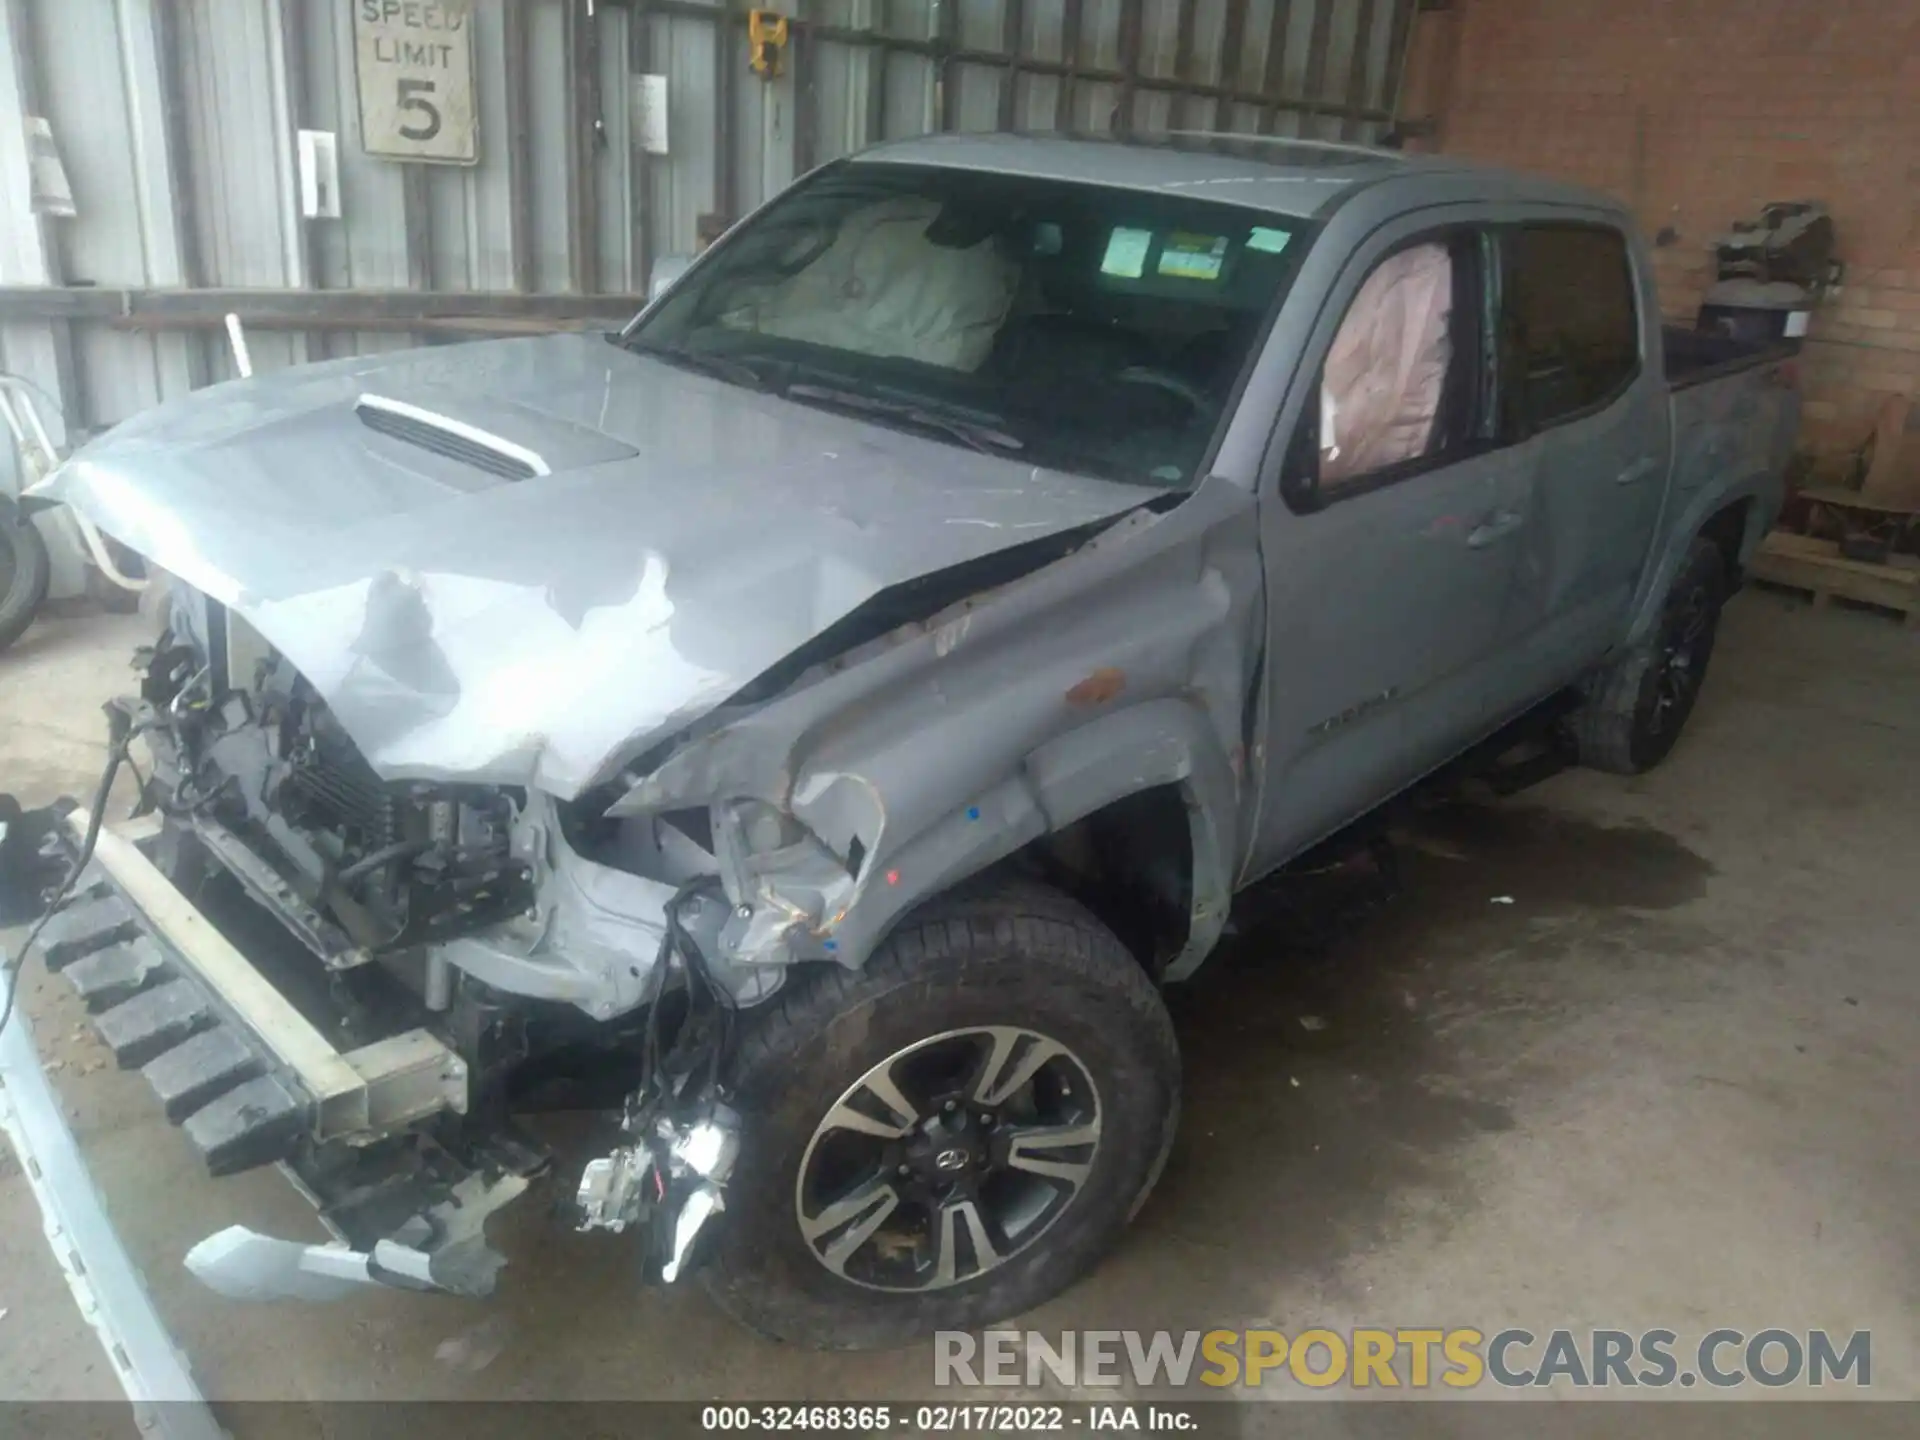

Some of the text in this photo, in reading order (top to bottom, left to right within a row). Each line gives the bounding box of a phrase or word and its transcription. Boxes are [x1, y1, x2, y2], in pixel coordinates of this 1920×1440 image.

[361, 0, 464, 31] SPEED
[375, 37, 453, 69] LIMIT
[397, 78, 442, 141] 5
